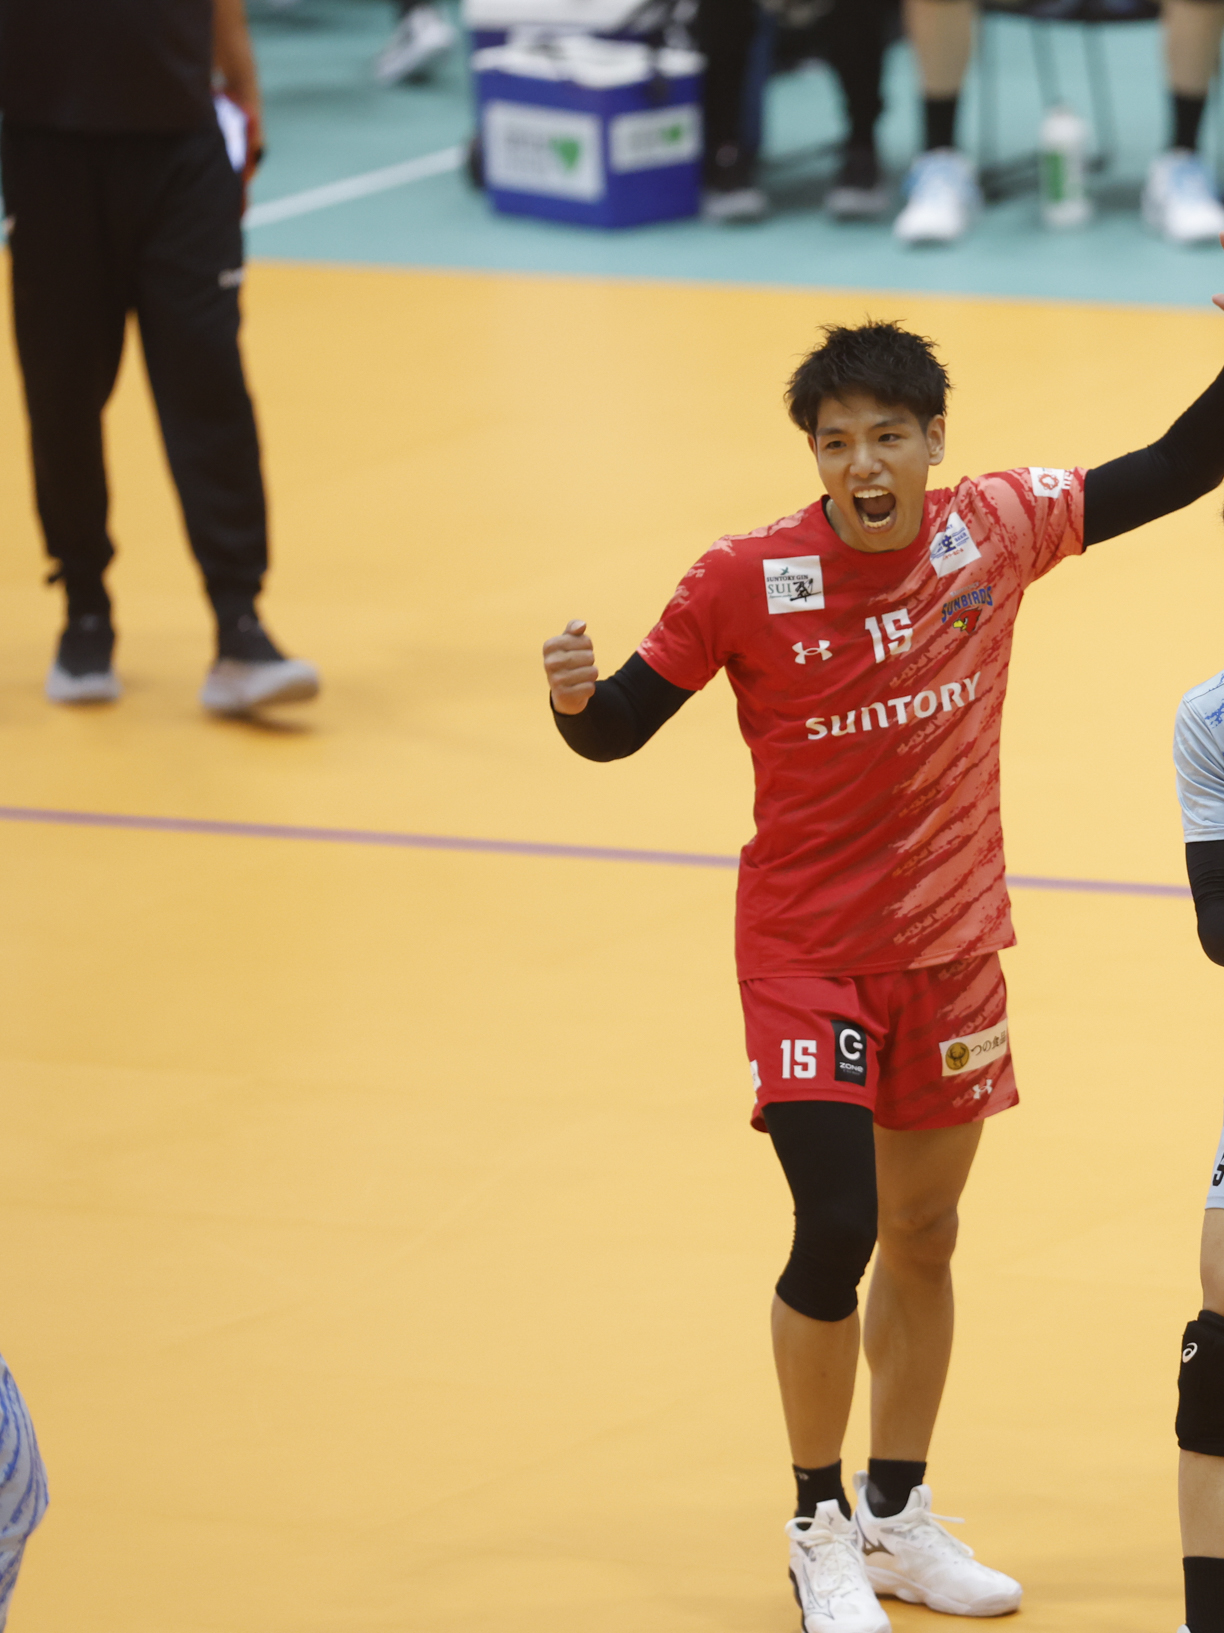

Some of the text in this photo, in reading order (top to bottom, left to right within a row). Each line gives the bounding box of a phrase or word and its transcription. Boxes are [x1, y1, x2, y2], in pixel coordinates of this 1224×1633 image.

[767, 583, 791, 594] SUI
[941, 585, 993, 623] SUNBIRDS
[864, 608, 914, 664] 15
[805, 671, 981, 740] SUNTORY
[780, 1039, 817, 1079] 15
